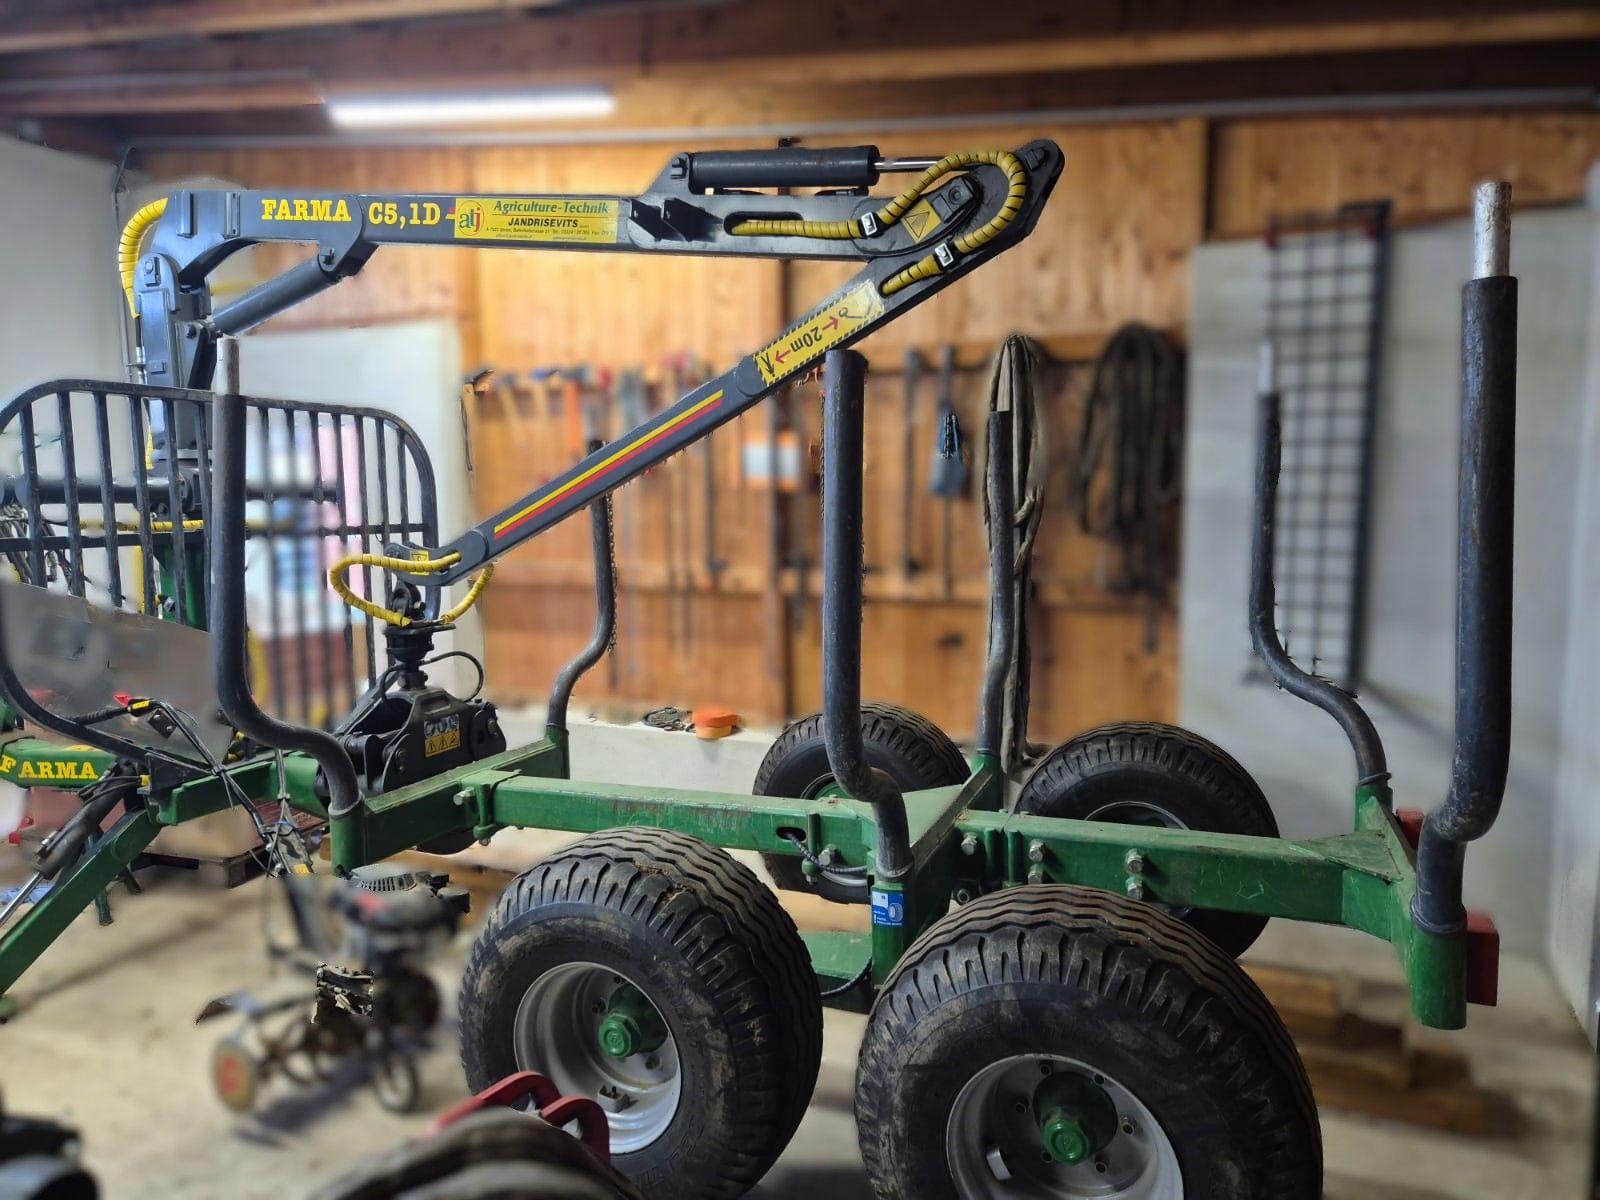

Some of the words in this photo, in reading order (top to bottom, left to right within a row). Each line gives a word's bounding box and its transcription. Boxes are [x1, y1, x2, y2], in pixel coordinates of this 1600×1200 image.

[261, 199, 352, 221] FARMA
[368, 202, 441, 229] C5,1D
[459, 207, 481, 232] atj
[494, 200, 609, 214] Agriculture-Technik
[508, 217, 579, 228] JANDRISEVITS
[790, 326, 823, 352] 20m
